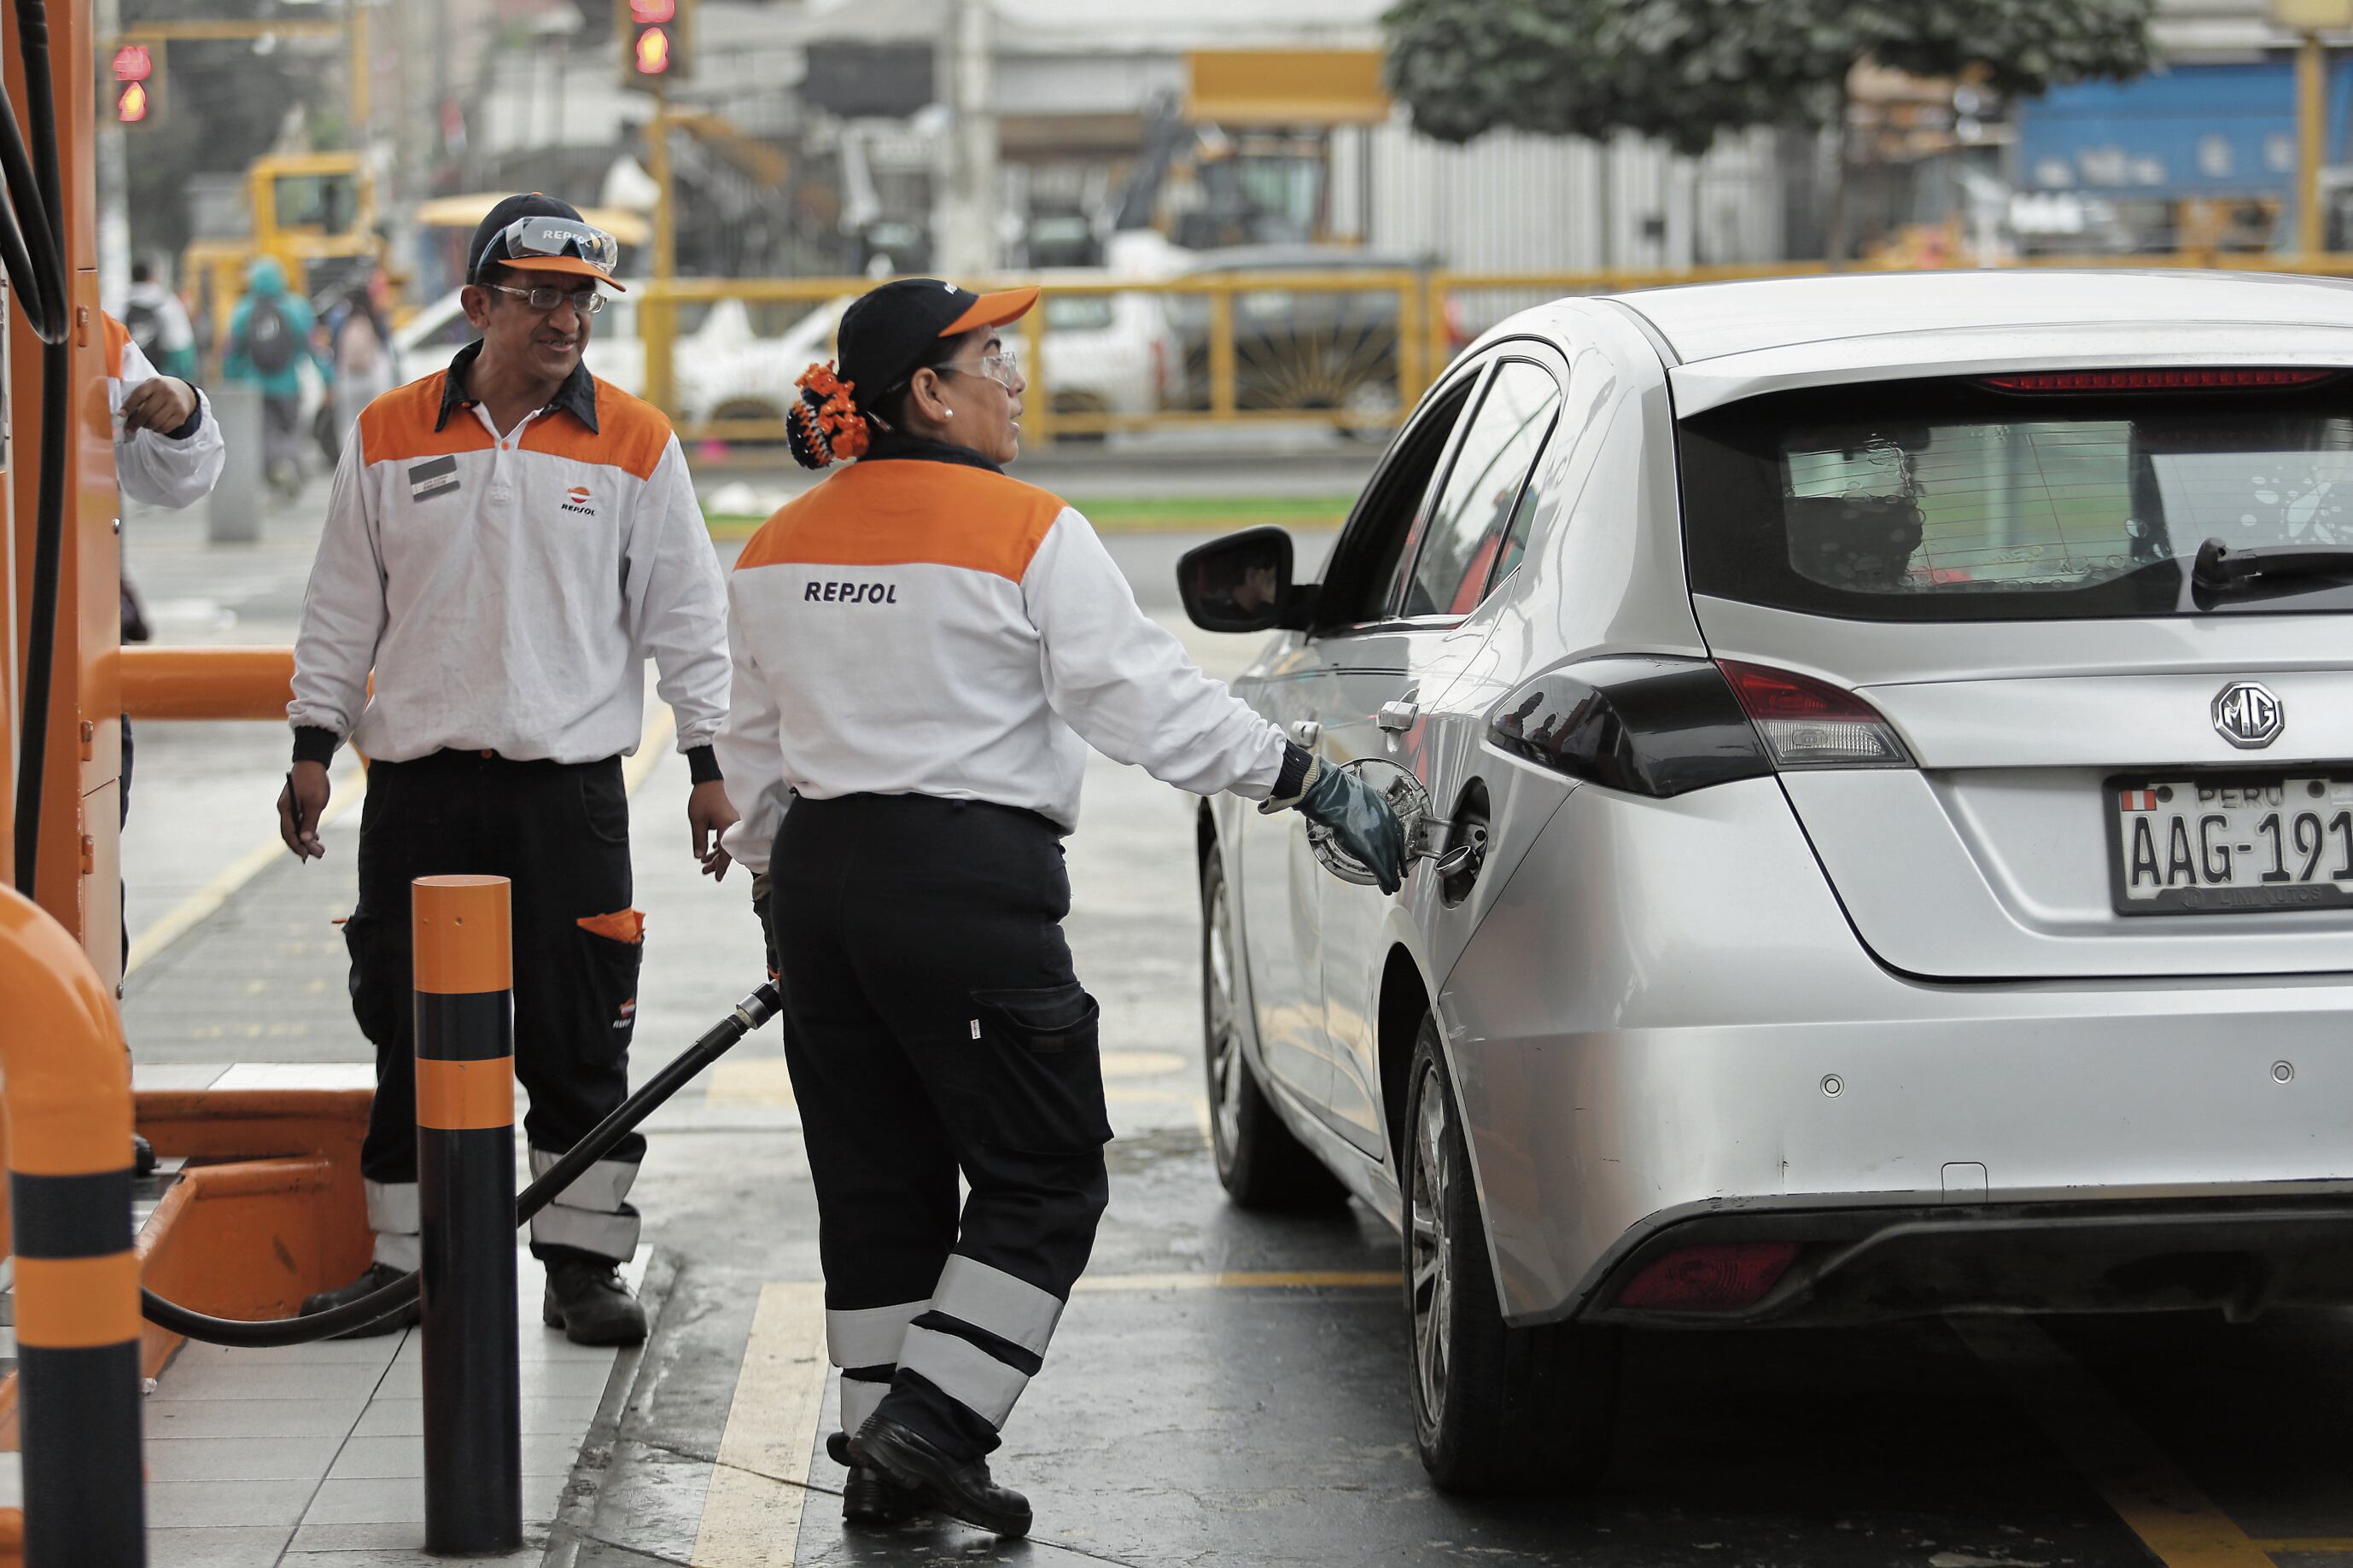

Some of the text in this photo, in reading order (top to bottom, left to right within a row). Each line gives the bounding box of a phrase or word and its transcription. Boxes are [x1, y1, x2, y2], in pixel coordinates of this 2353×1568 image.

[804, 581, 897, 604] REPSOL
[2222, 688, 2277, 737] MG
[2197, 785, 2285, 808] PERU
[2131, 811, 2353, 885] AAG-191
